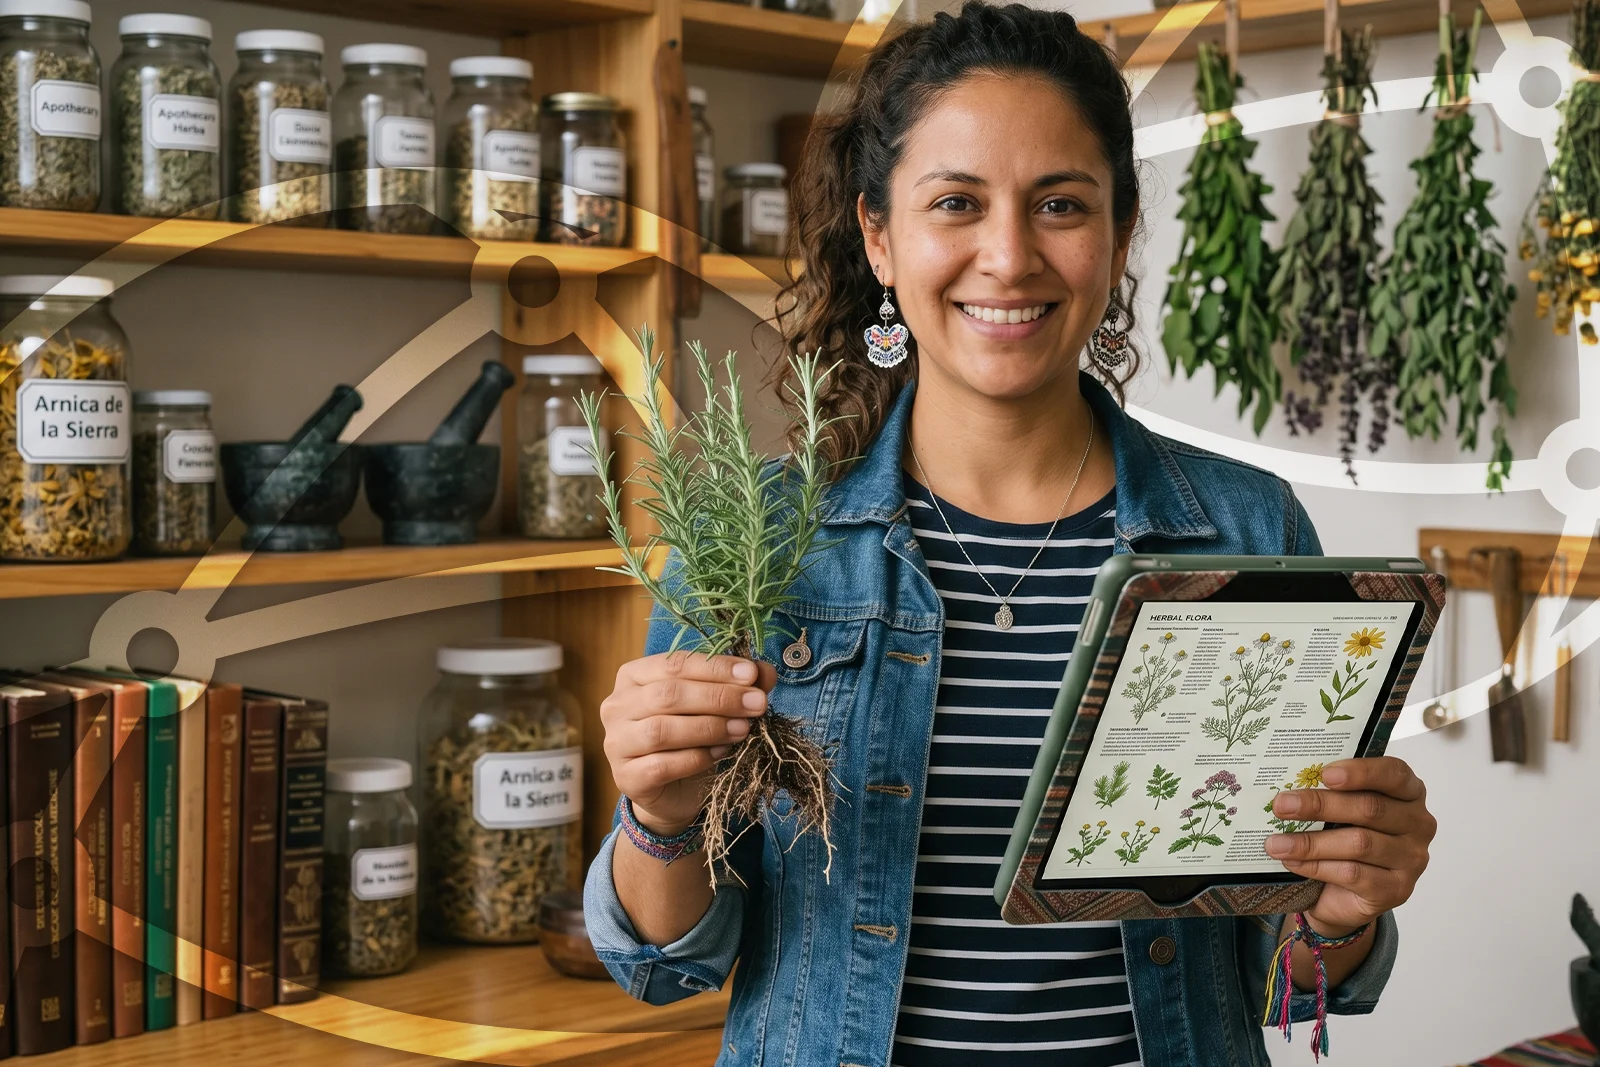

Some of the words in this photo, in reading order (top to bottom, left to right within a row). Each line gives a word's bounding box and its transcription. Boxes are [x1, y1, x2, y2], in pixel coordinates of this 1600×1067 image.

[34, 394, 99, 413] Arnica
[105, 394, 123, 413] de
[41, 420, 58, 438] la
[66, 420, 118, 438] Sierra
[500, 767, 555, 785] Arnica
[557, 763, 574, 781] de
[505, 791, 521, 809] la
[526, 790, 569, 809] Sierra
